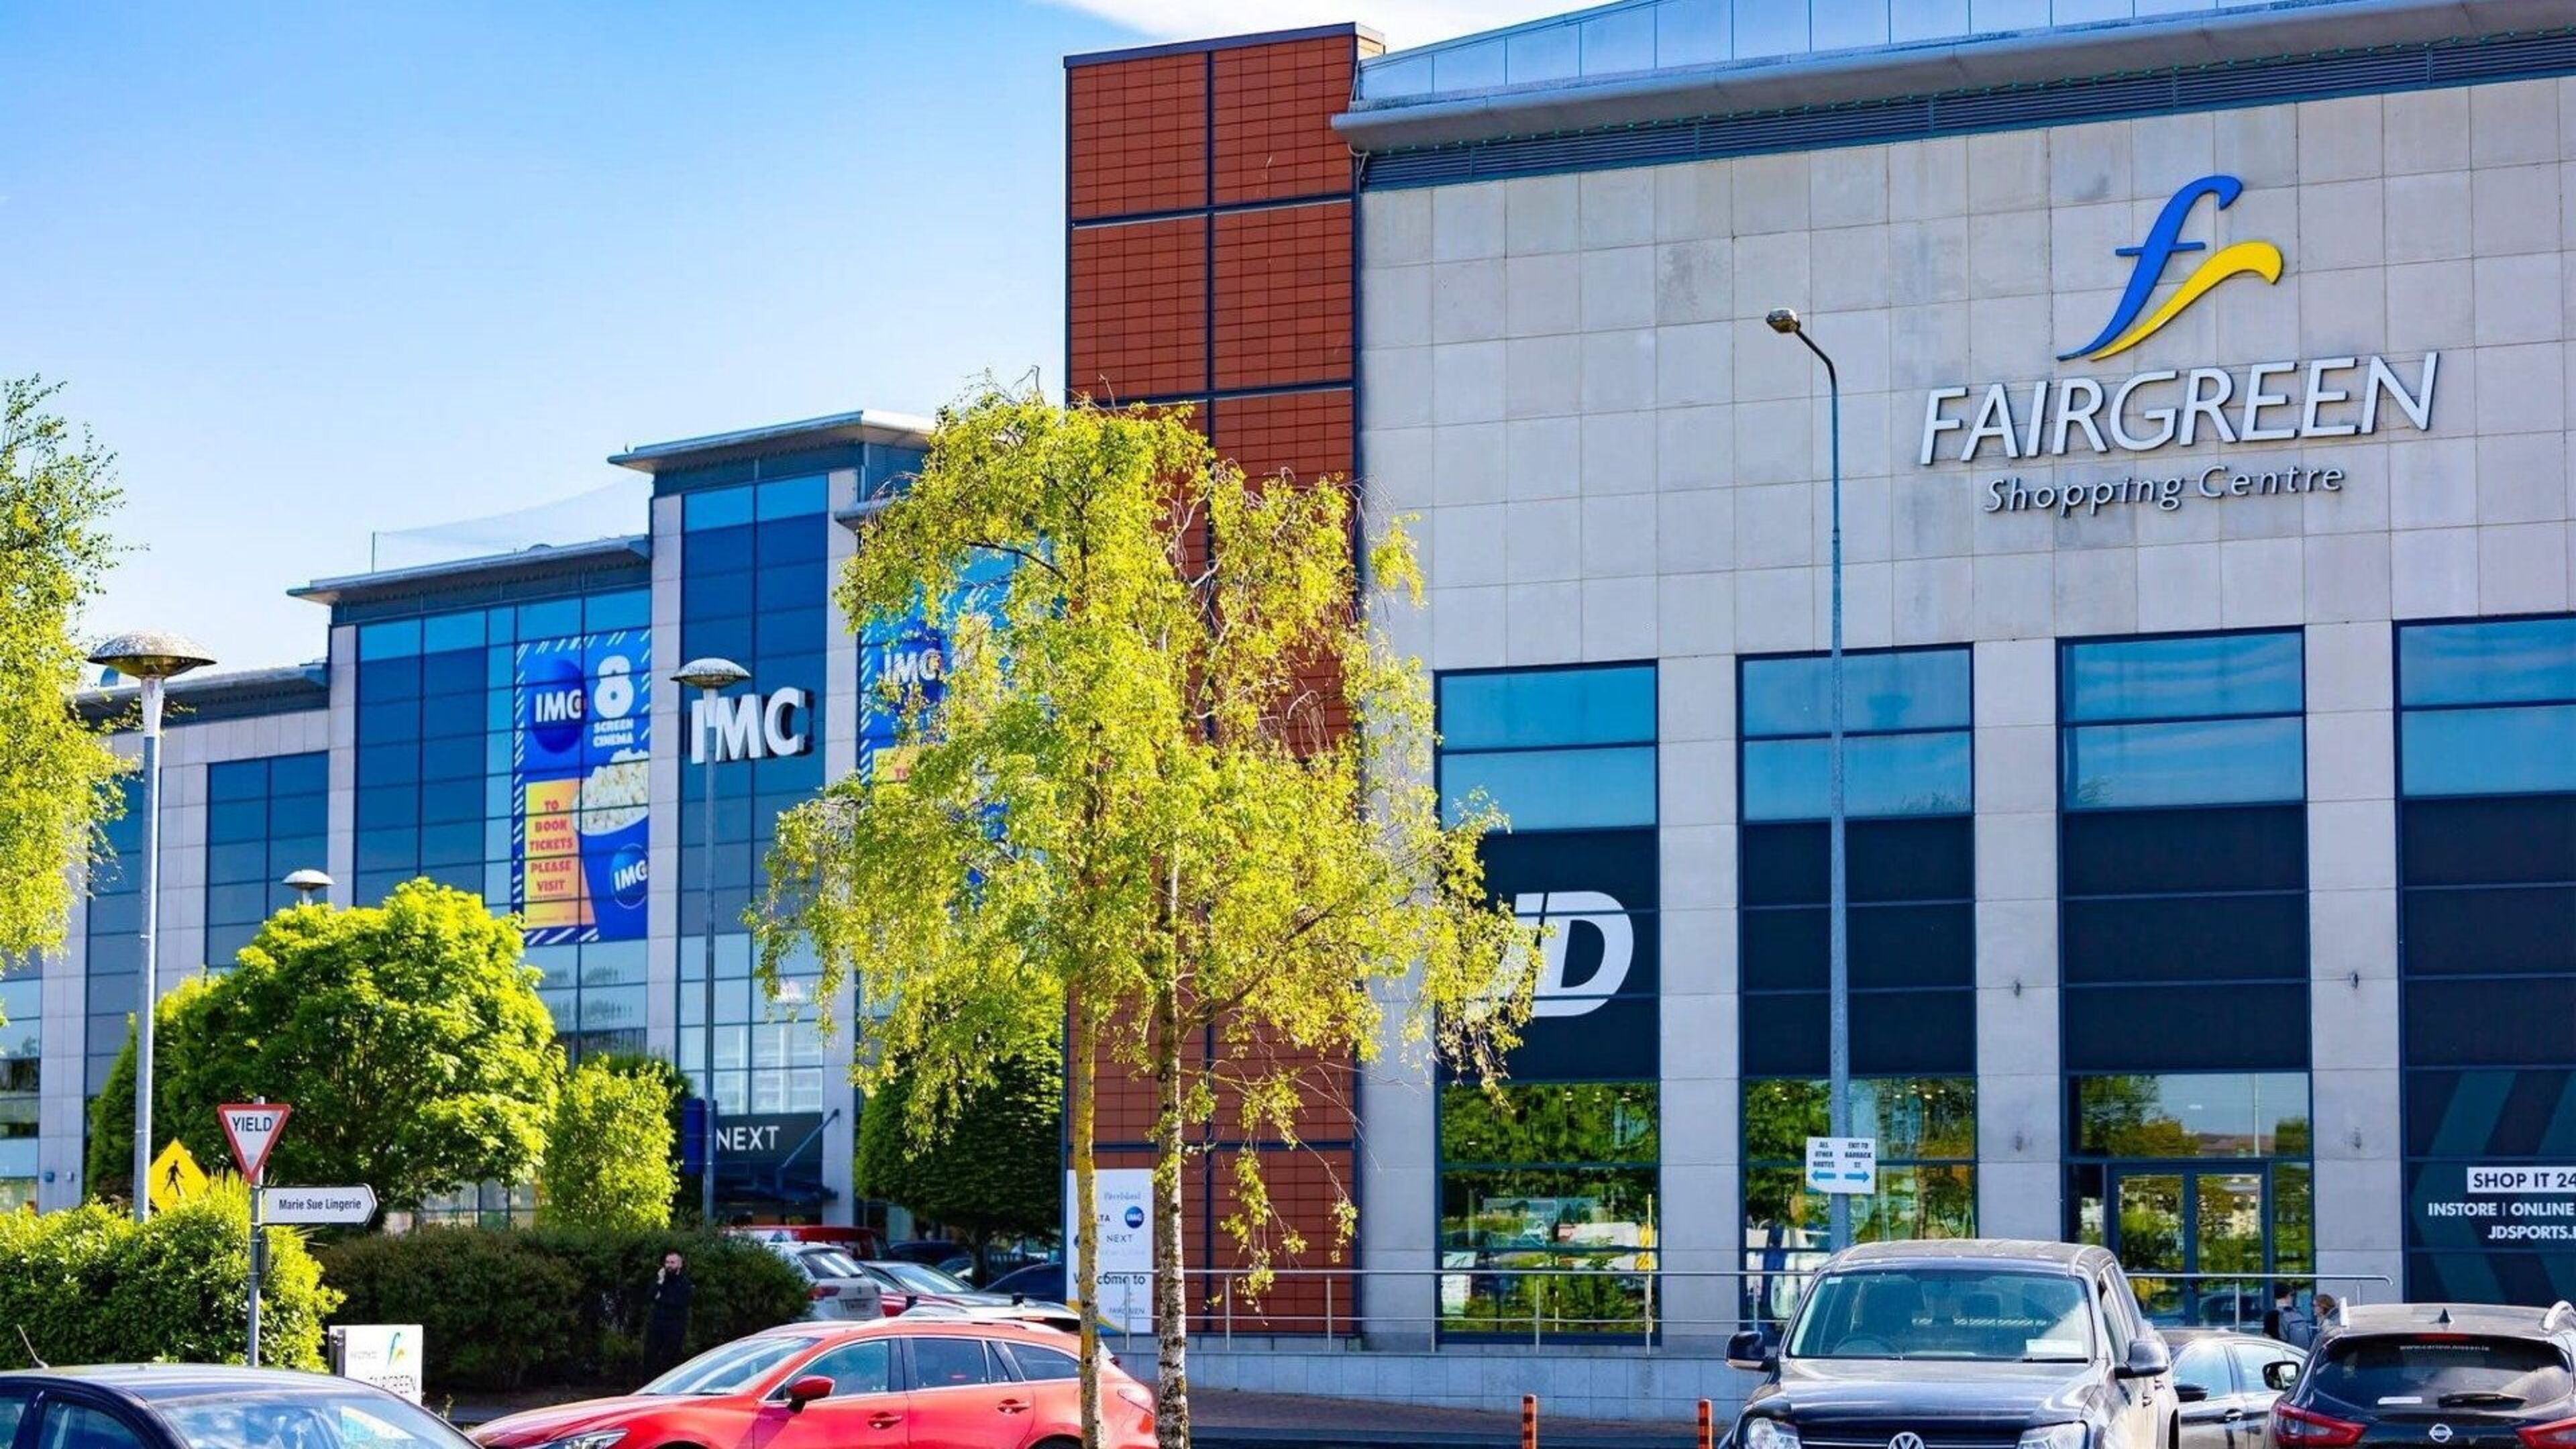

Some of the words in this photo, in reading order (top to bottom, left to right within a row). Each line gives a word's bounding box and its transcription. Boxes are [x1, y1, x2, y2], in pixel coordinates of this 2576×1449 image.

[1921, 352, 2439, 465] FAIRGREEN
[1984, 476, 2183, 518] Shopping
[2198, 464, 2345, 498] Centre
[594, 655, 633, 718] 8
[535, 690, 582, 722] IMC
[594, 718, 633, 733] SCREEN
[692, 687, 805, 764] IMC
[593, 732, 633, 747] CINEMA
[545, 800, 559, 811] TO
[535, 820, 567, 832] BOOK
[530, 839, 572, 851] TICKETS
[531, 861, 571, 872] PLEASE
[614, 860, 647, 891] IMC
[537, 880, 565, 892] VISIT
[232, 1117, 272, 1132] YIELD
[715, 1126, 780, 1151] NEXT
[2473, 1173, 2527, 1187] SHOP
[2534, 1173, 2550, 1187] IT
[279, 1199, 304, 1210] Marie
[307, 1199, 323, 1210] Sue
[325, 1198, 362, 1212] Lingerie
[2428, 1203, 2497, 1216] INSTORE
[2510, 1203, 2575, 1216] ONLINE
[1107, 1234, 1132, 1243] NEXT
[1134, 1275, 1145, 1285] to
